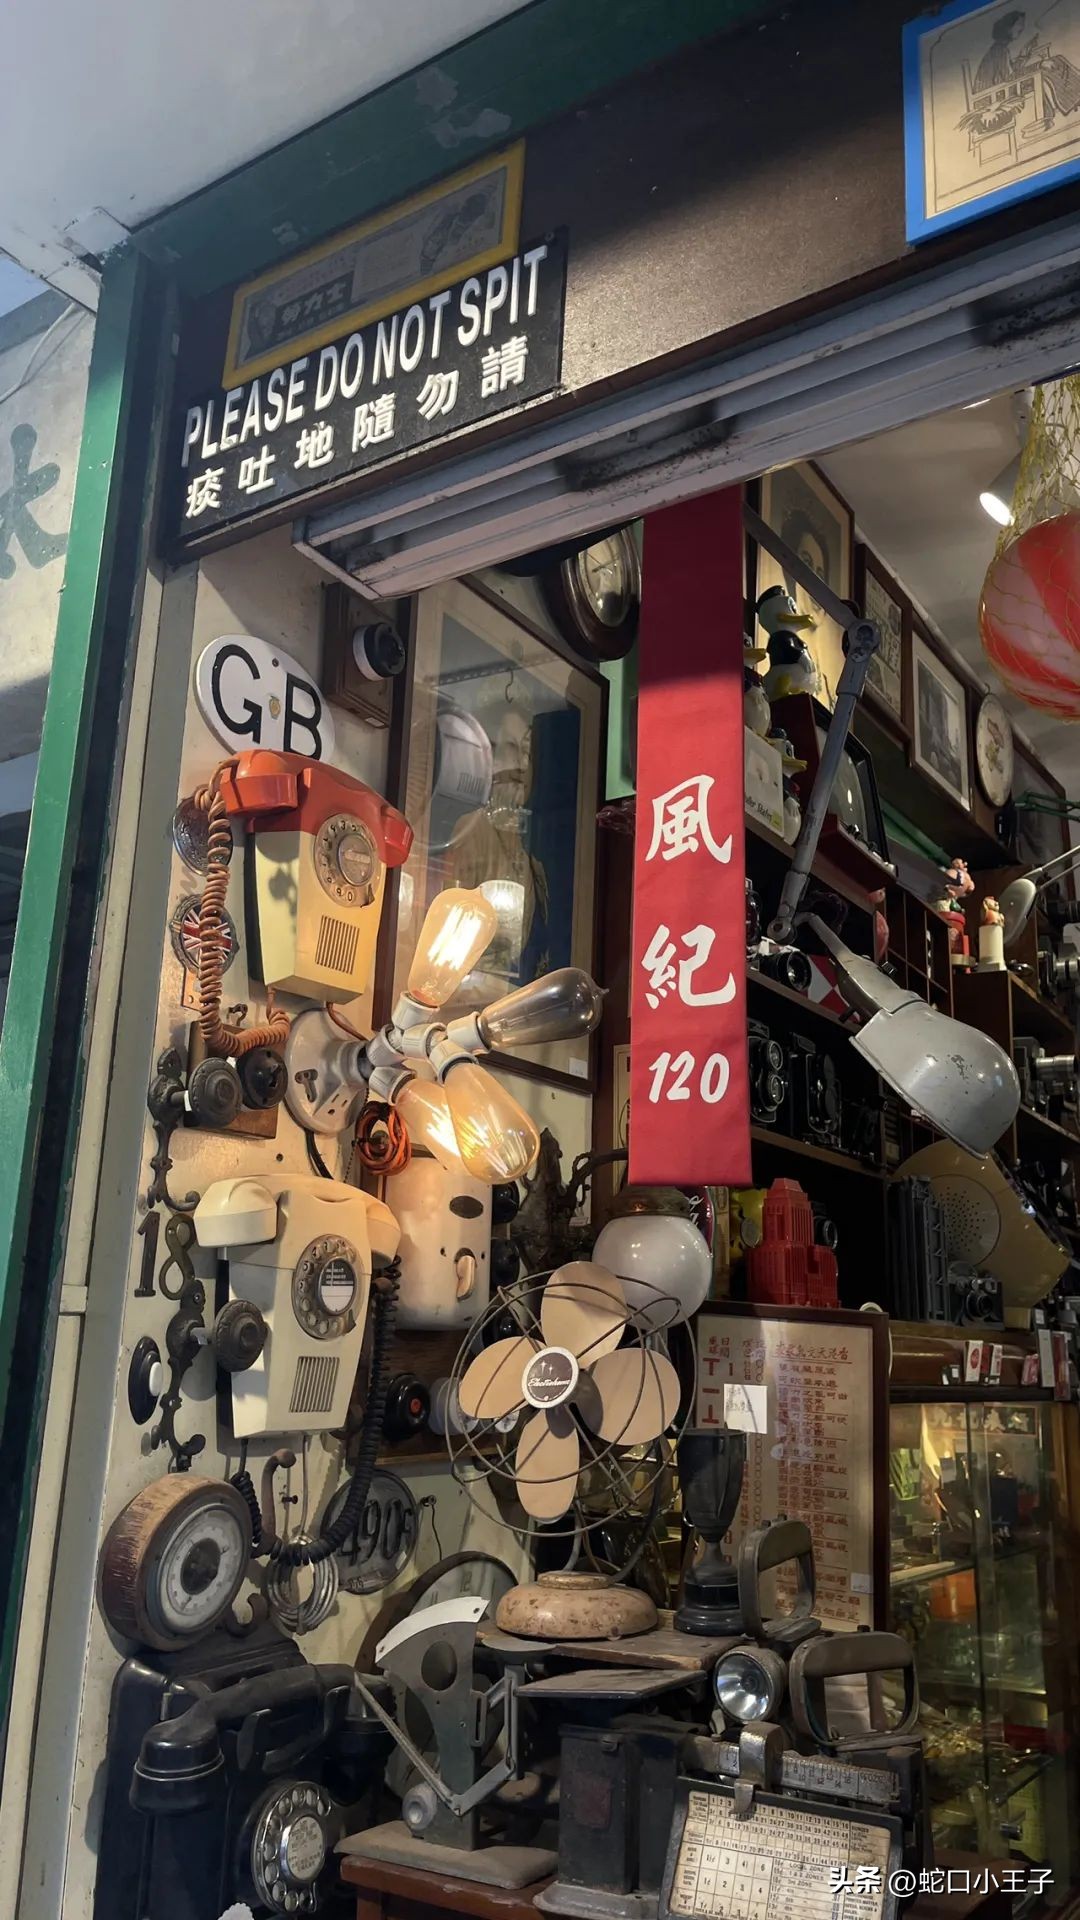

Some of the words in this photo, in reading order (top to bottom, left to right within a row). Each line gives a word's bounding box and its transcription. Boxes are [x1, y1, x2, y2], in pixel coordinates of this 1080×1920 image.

[182, 362, 307, 467] PLEASE
[315, 333, 365, 411] DO
[373, 297, 449, 385] NOT
[458, 244, 548, 346] SPIT
[647, 1050, 730, 1104] 120
